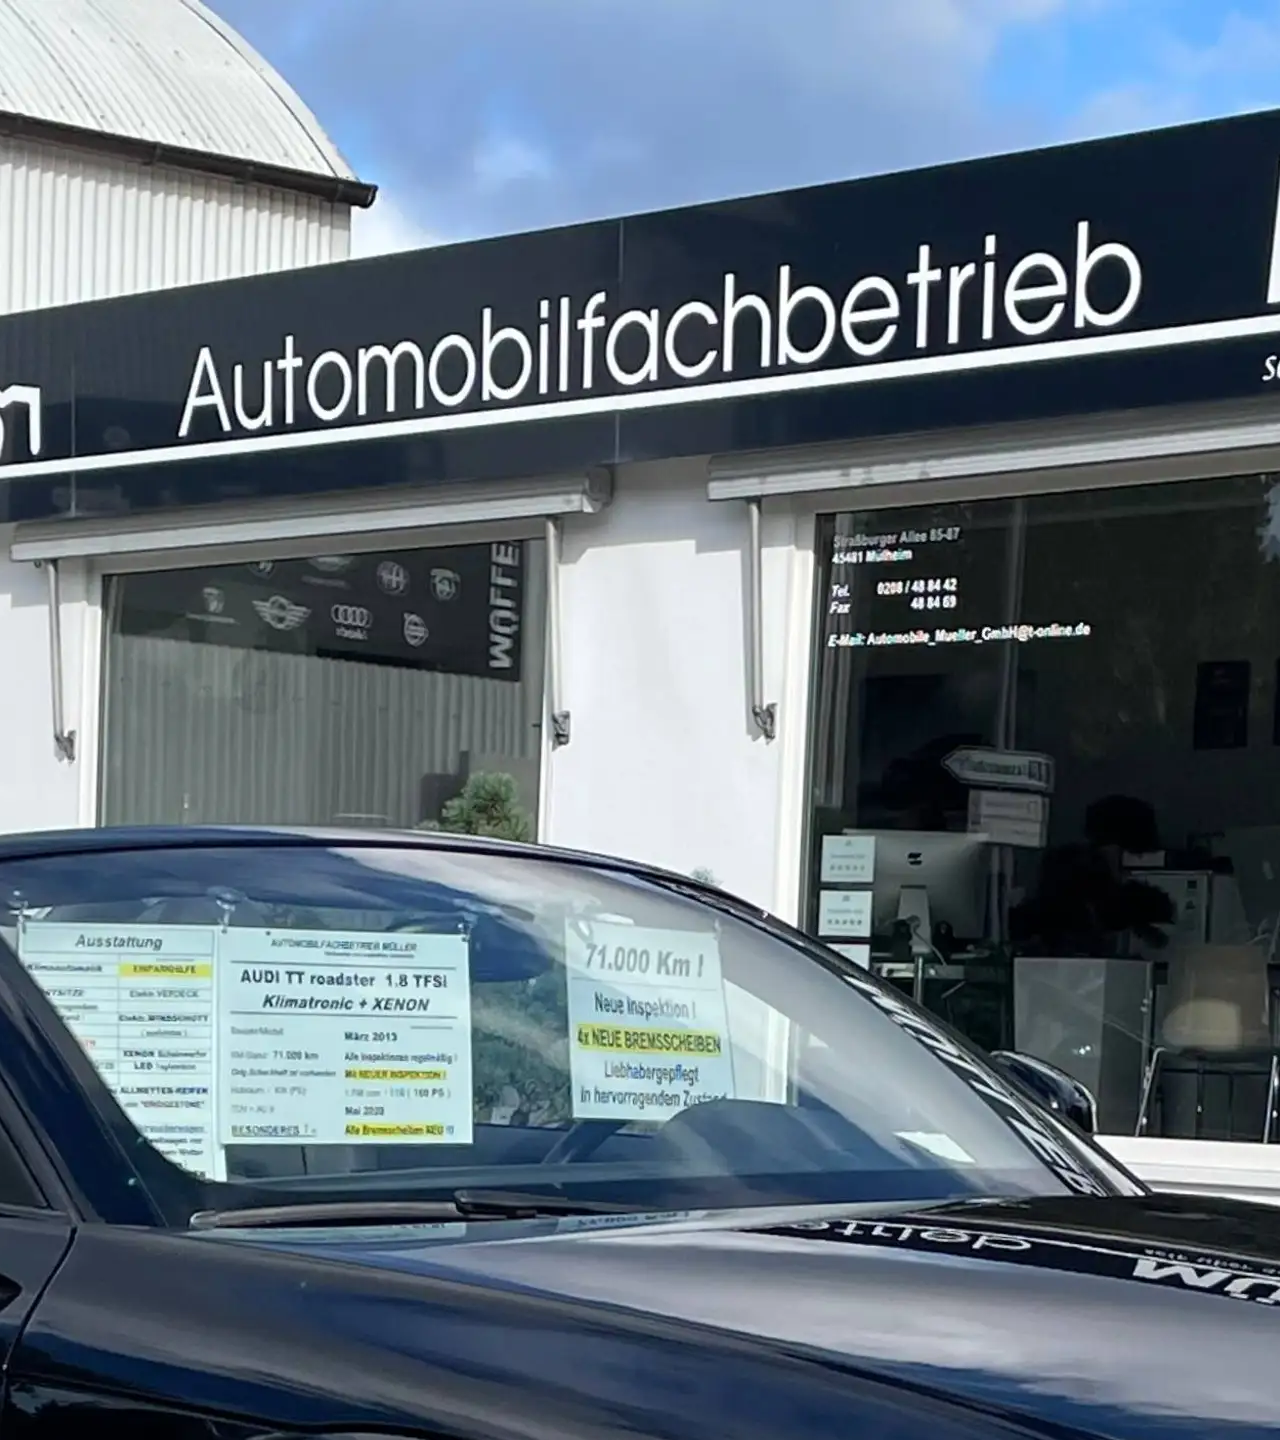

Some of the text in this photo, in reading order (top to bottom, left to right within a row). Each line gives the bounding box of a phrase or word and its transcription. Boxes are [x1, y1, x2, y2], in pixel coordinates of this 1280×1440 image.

[177, 220, 1143, 438] Automobilfachbetrieb
[74, 934, 163, 951] Ausstattung
[585, 942, 704, 978] 71.000 Km !
[240, 968, 280, 985] AUDI
[285, 970, 305, 985] TT
[309, 972, 376, 987] roadster
[262, 994, 430, 1012] Klimatronic + XENON
[594, 991, 624, 1015] Neue
[577, 1027, 721, 1053] 4x NEUE BREMSSCHEIBEN
[604, 1060, 700, 1087] Liebhabergepflegt
[593, 1086, 681, 1110] hervorragendem
